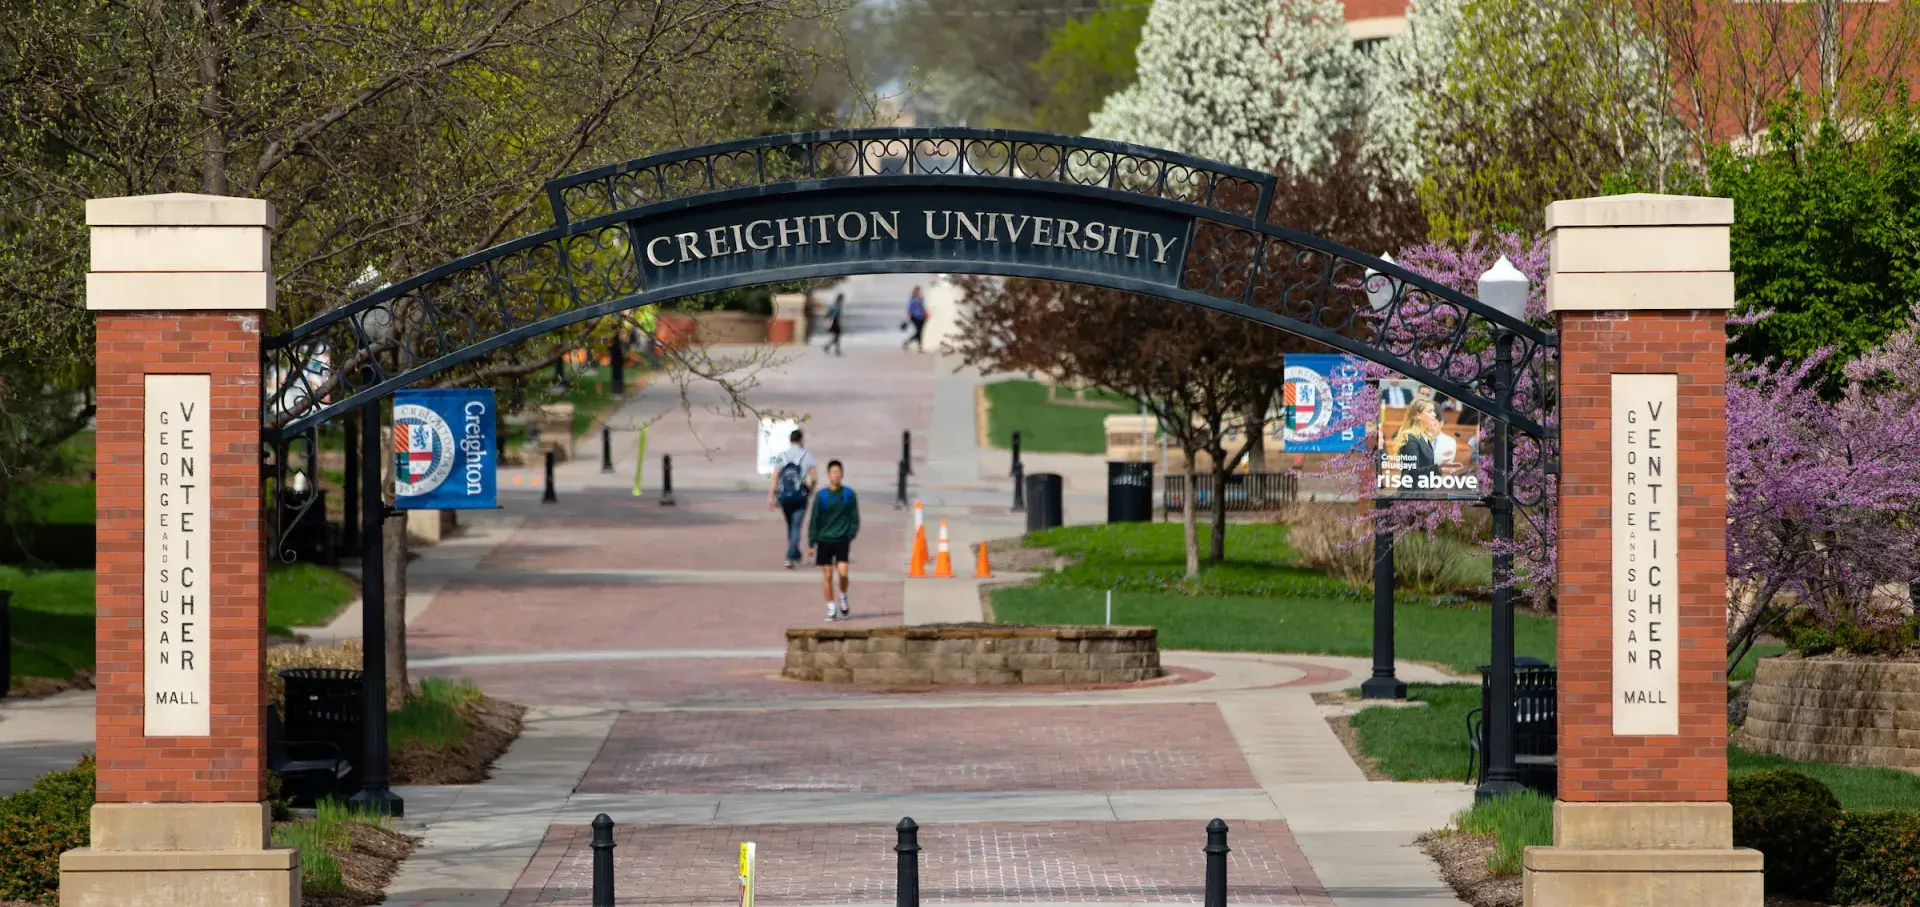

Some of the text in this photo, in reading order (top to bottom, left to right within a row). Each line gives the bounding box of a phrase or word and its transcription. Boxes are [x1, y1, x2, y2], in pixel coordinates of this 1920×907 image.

[646, 210, 1178, 268] CREIGHTON UNIVERSITY
[160, 411, 169, 527] GEORGE
[460, 401, 487, 496] Creighton
[1377, 469, 1478, 489] rise above
[1381, 453, 1417, 462] Creighton
[1381, 461, 1417, 471] Bluejays
[1627, 410, 1637, 526] GEORGE
[180, 402, 196, 671] VENTEICHER
[1647, 401, 1663, 670] VENTEICHER
[160, 569, 169, 665] SUSAN
[1627, 568, 1637, 664] SUSAN
[156, 691, 198, 705] MALL
[1624, 690, 1667, 704] MALL
